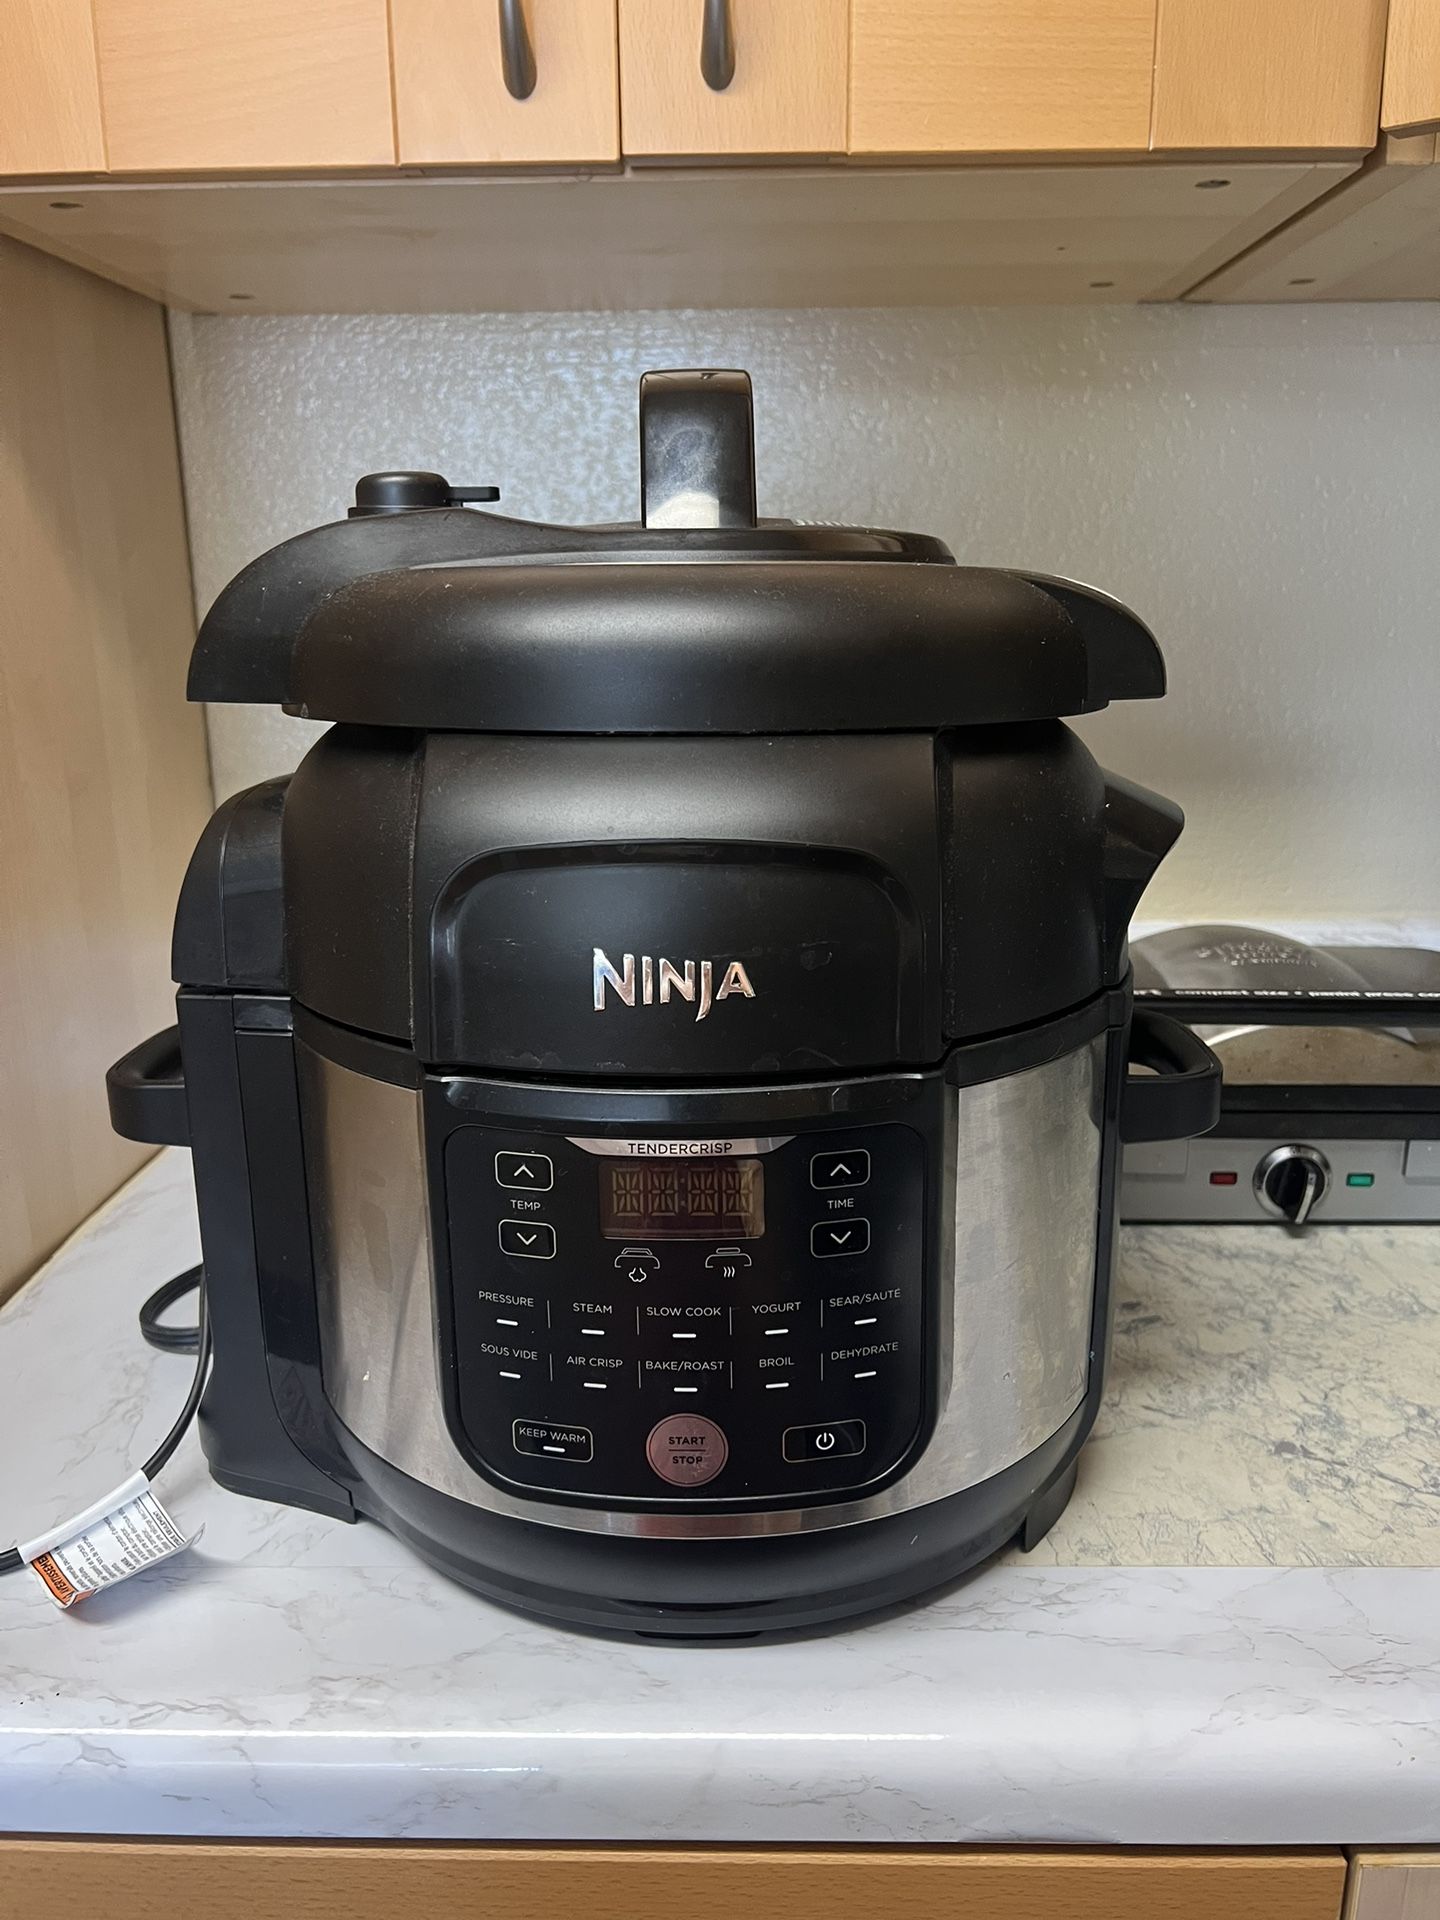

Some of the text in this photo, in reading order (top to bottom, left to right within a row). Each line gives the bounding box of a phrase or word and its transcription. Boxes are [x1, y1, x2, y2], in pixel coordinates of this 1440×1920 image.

[593, 948, 756, 1023] NINJA
[628, 1142, 733, 1155] TENDERCRISP
[510, 1200, 540, 1210] TEMP
[828, 1198, 853, 1208] TIME
[479, 1291, 533, 1307] PRESSURE
[573, 1303, 612, 1313] STEAM
[647, 1307, 721, 1316] SLOW COOK
[752, 1302, 800, 1313] YOGURT
[481, 1343, 537, 1360] SOUS VIDE
[831, 1342, 898, 1360] DEHYDRATE
[567, 1356, 623, 1367] AIR CRISP
[646, 1361, 724, 1371] BAKE/ROAST
[760, 1357, 794, 1367] BROIL
[520, 1427, 585, 1443] KEEP WARM
[669, 1437, 705, 1445] START
[673, 1456, 702, 1464] STOP
